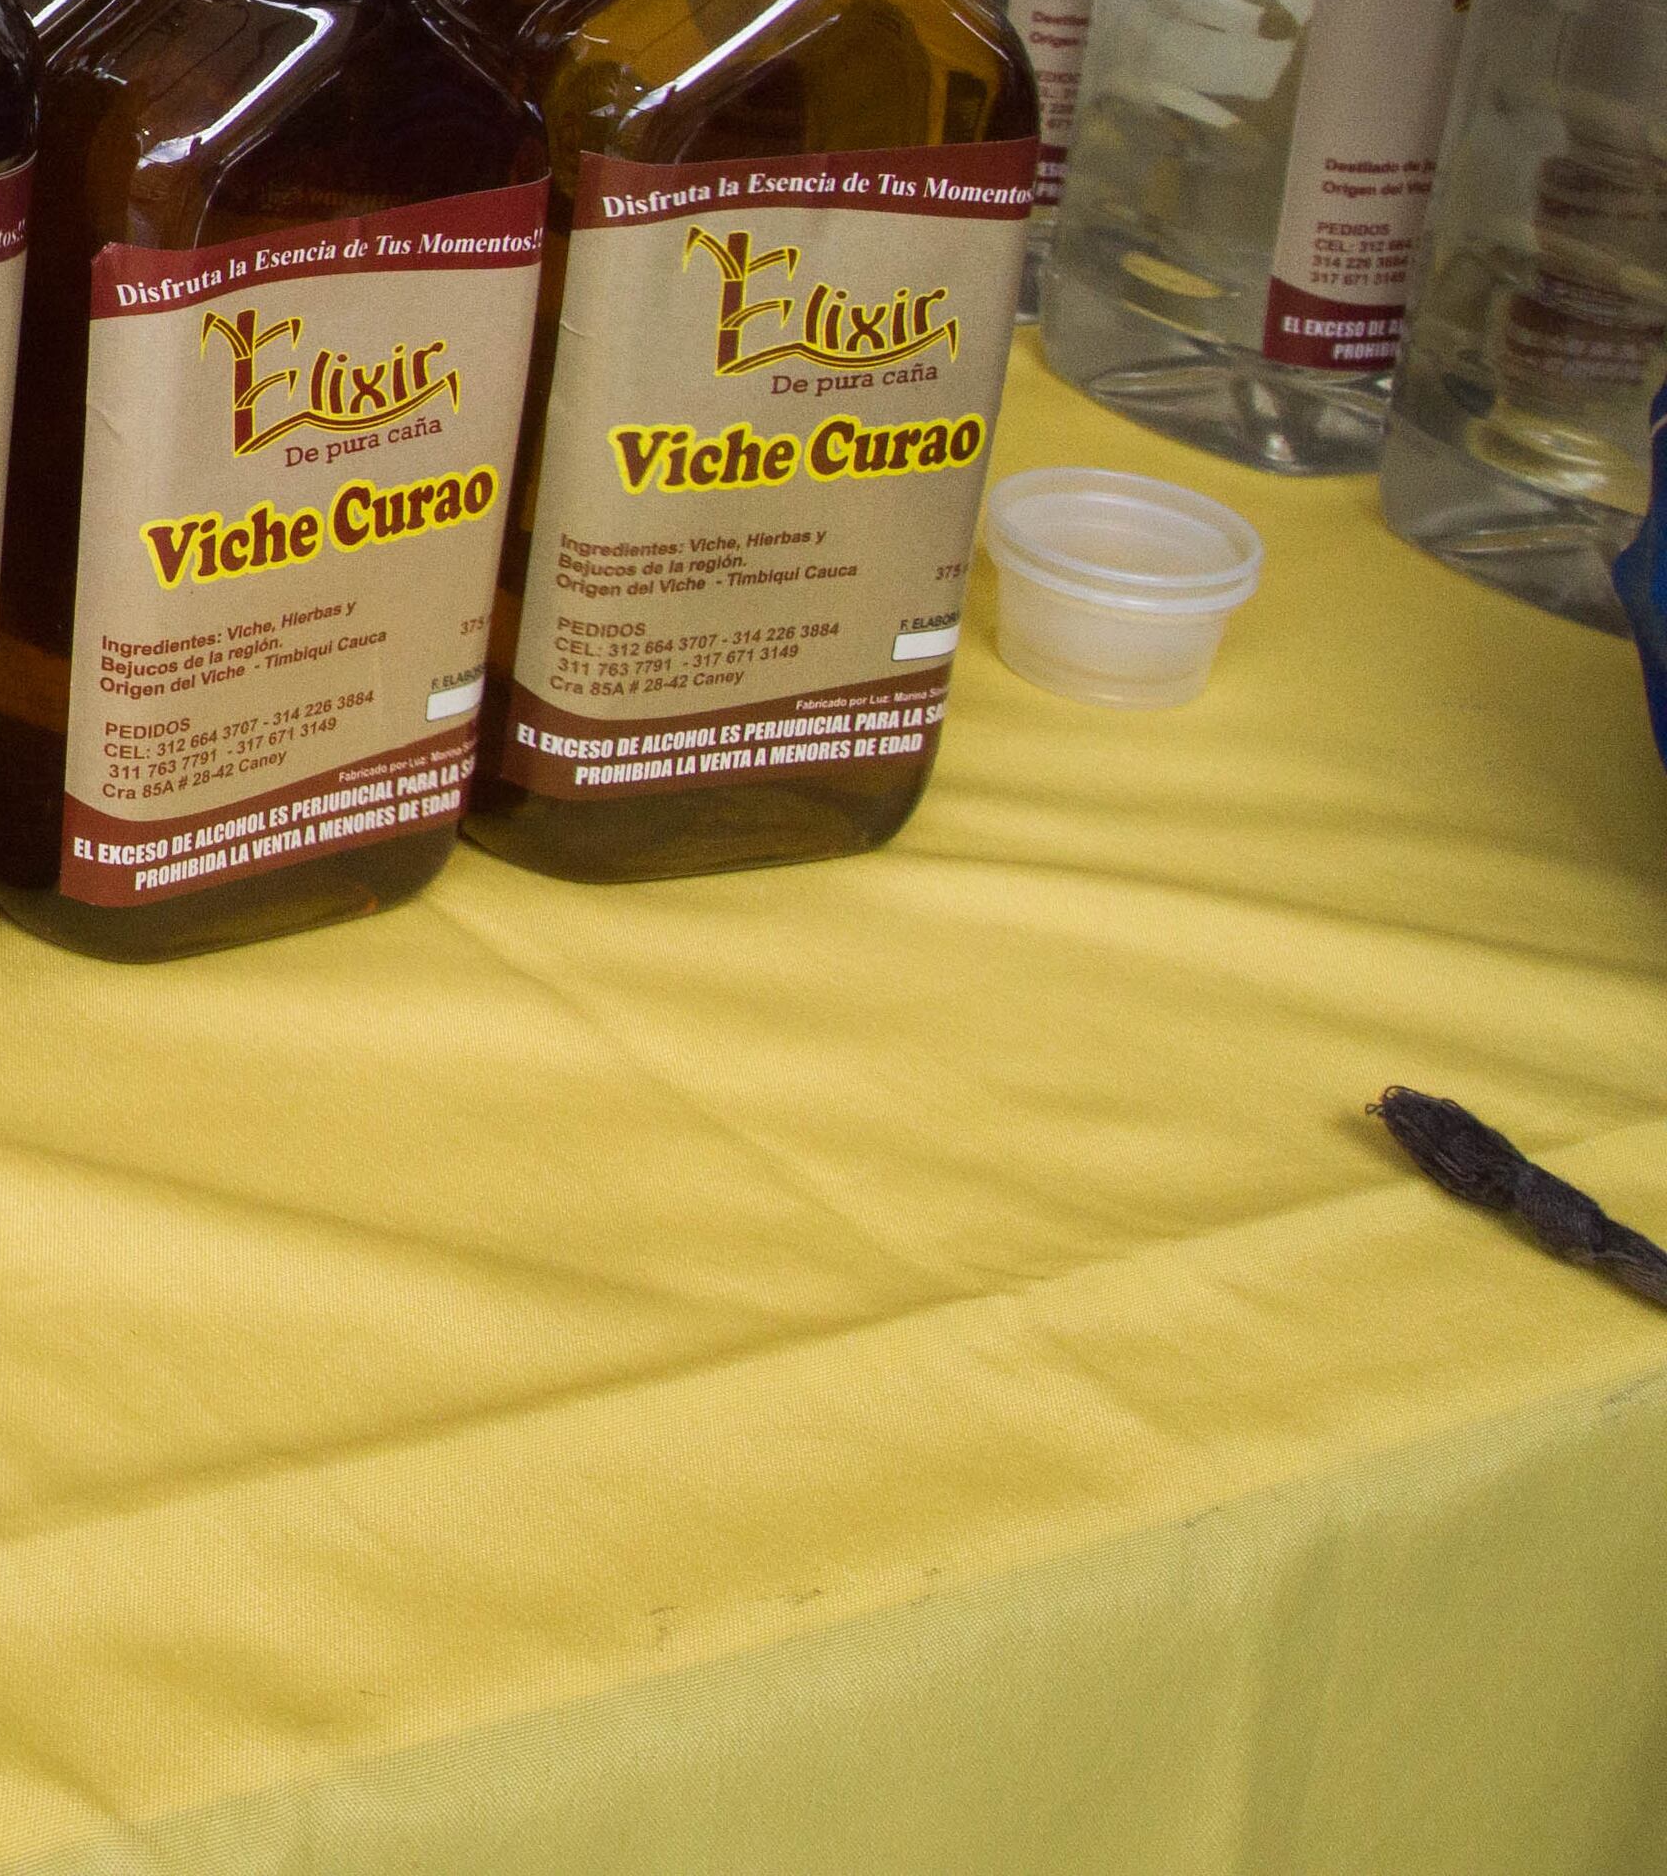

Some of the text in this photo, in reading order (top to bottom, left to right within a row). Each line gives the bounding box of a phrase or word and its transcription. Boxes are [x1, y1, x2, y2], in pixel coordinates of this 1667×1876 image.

[603, 185, 710, 218] Disfruta
[718, 177, 739, 197] la
[748, 173, 836, 194] Esencia
[843, 174, 870, 194] de
[877, 174, 916, 198] Tus
[116, 227, 543, 307] Disfruta la Esencia de Tus Momentos!!
[682, 226, 959, 376] Elixir
[201, 309, 460, 457] Elixir
[770, 363, 938, 397] De pura caña
[285, 417, 443, 467] De pura caña
[608, 414, 985, 495] Viche Curao
[140, 464, 499, 590] Viche Curao
[105, 718, 191, 739] PEDIDOS
[102, 750, 287, 800] Cra 85A # 28-42 Caney
[575, 734, 922, 786] PROHIBIDA LA VENTA A MENORES DE EDAD
